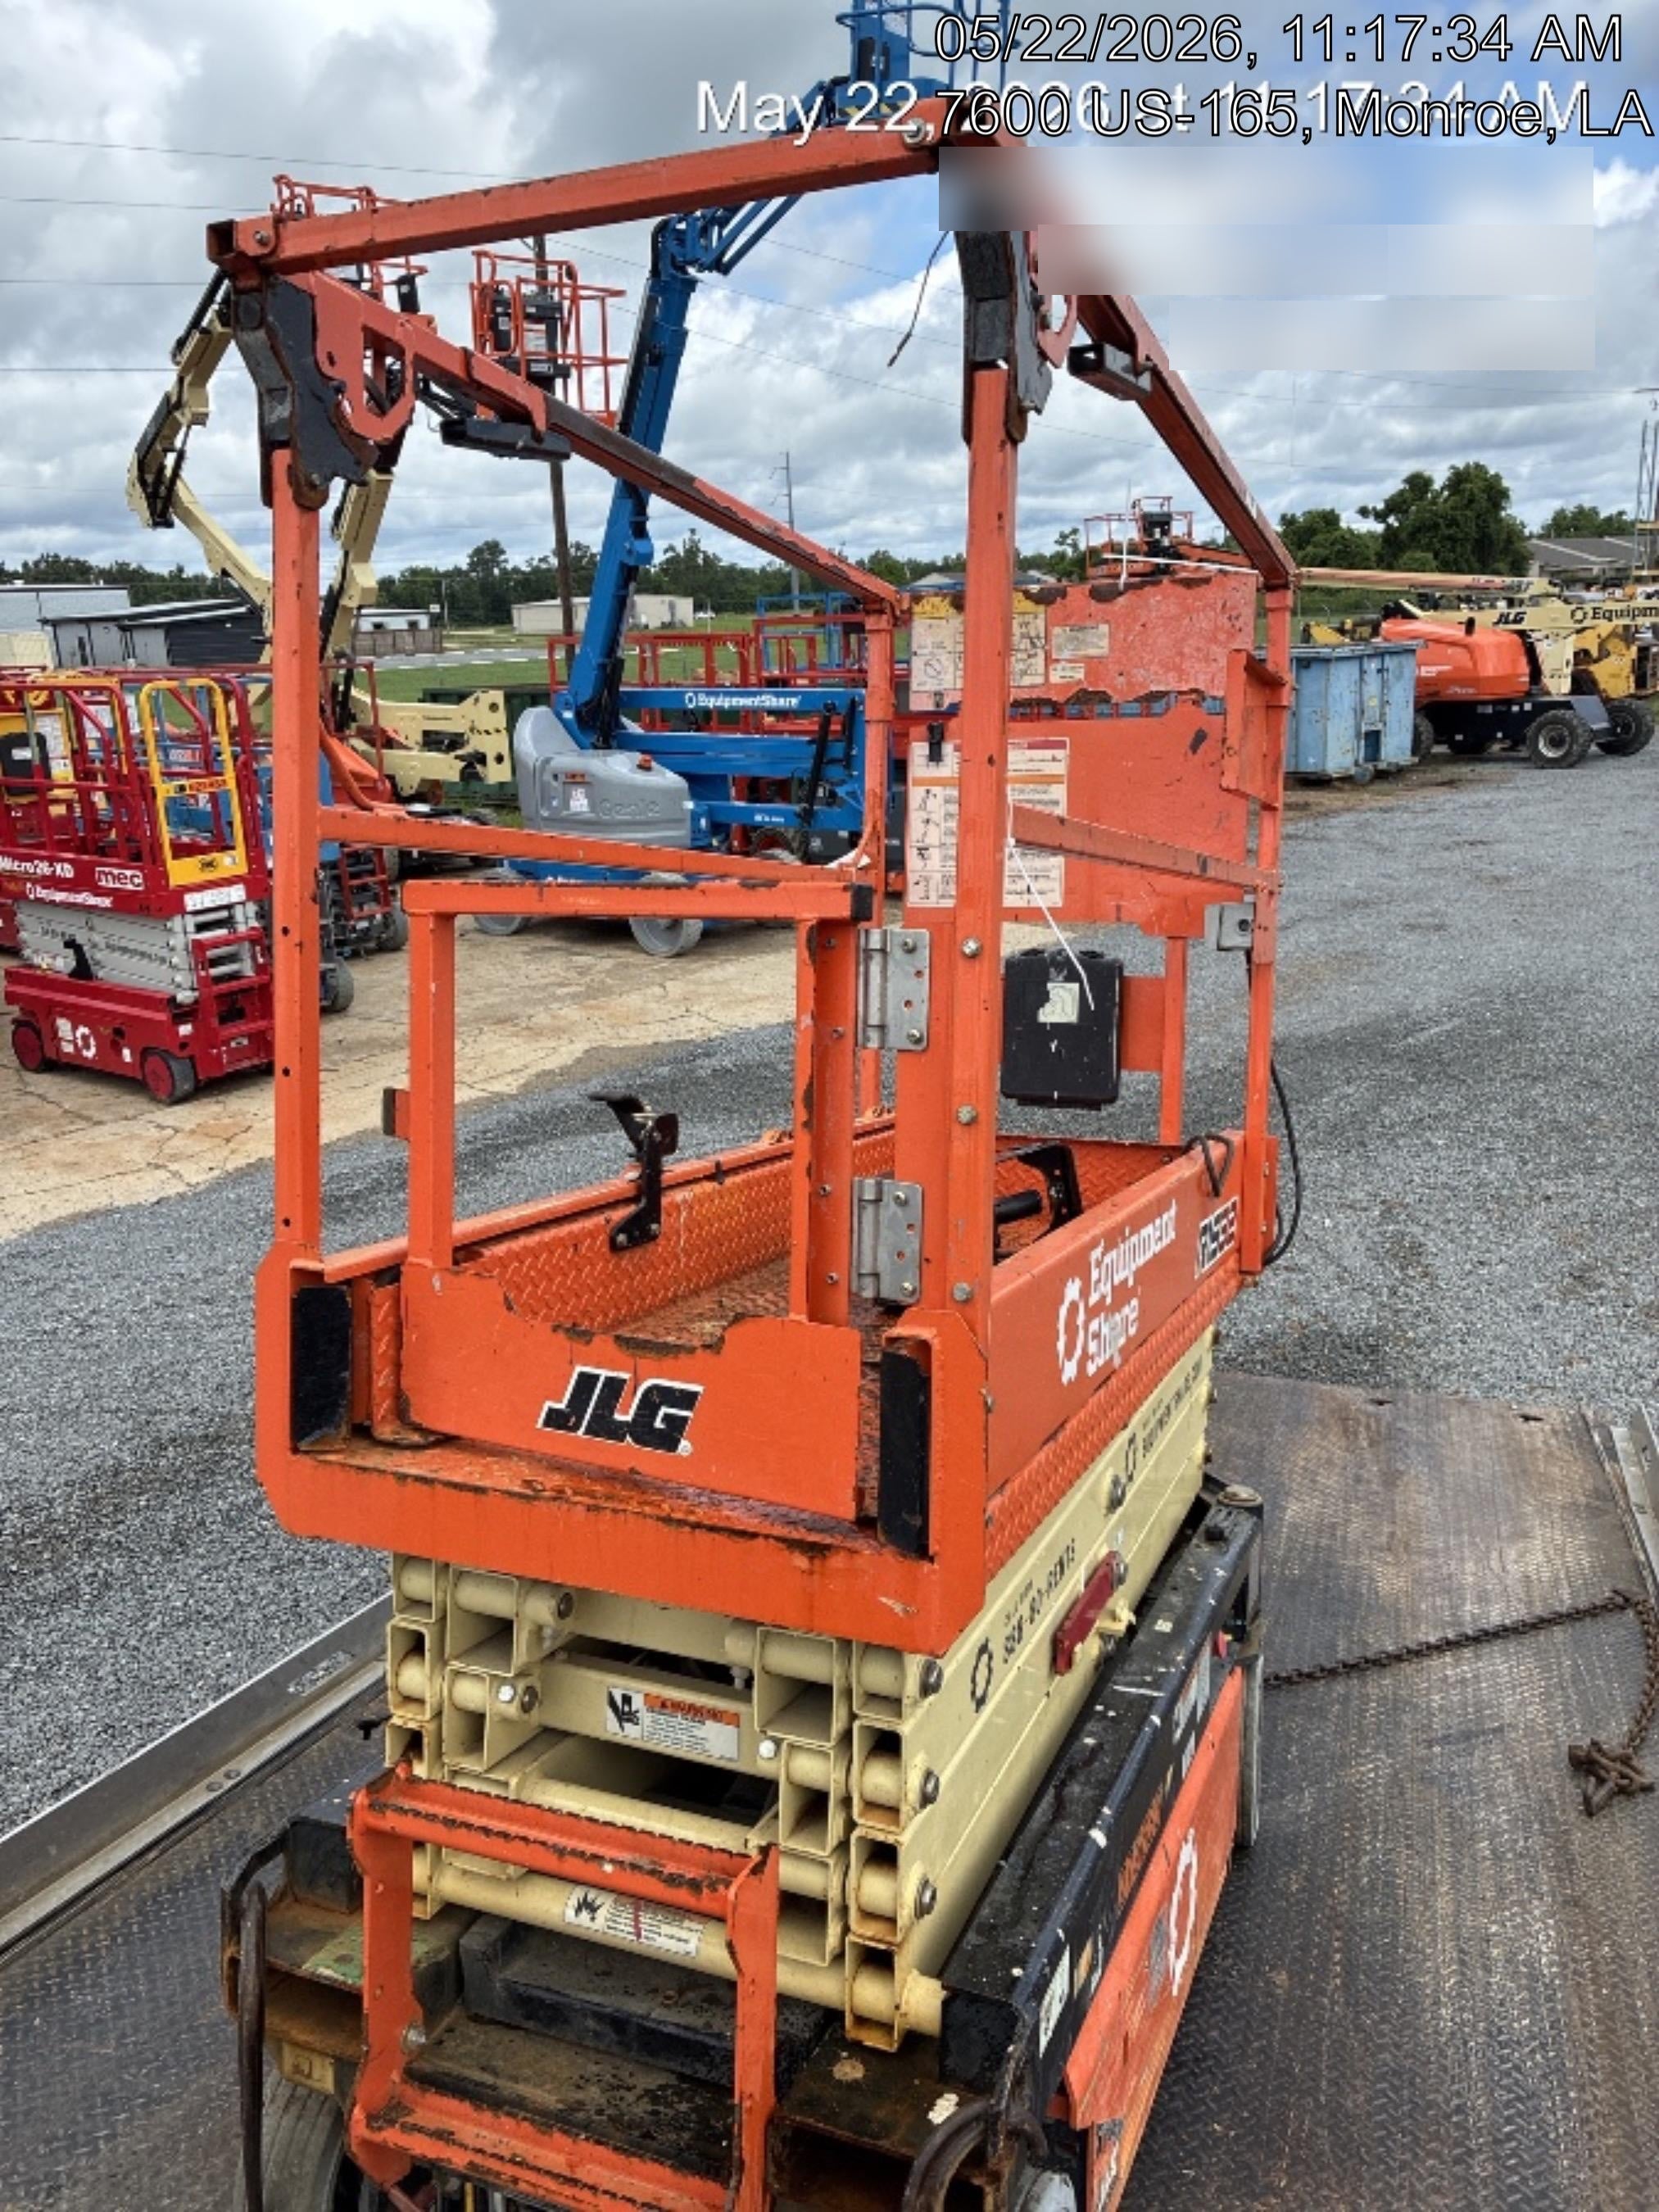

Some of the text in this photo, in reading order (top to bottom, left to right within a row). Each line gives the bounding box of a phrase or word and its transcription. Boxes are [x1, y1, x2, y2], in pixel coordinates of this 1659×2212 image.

[1493, 611, 1526, 625] JLG
[97, 870, 143, 888] mec
[1088, 1199, 1176, 1307] Equipment
[1086, 1297, 1140, 1377] Share
[536, 1365, 705, 1453] JLG
